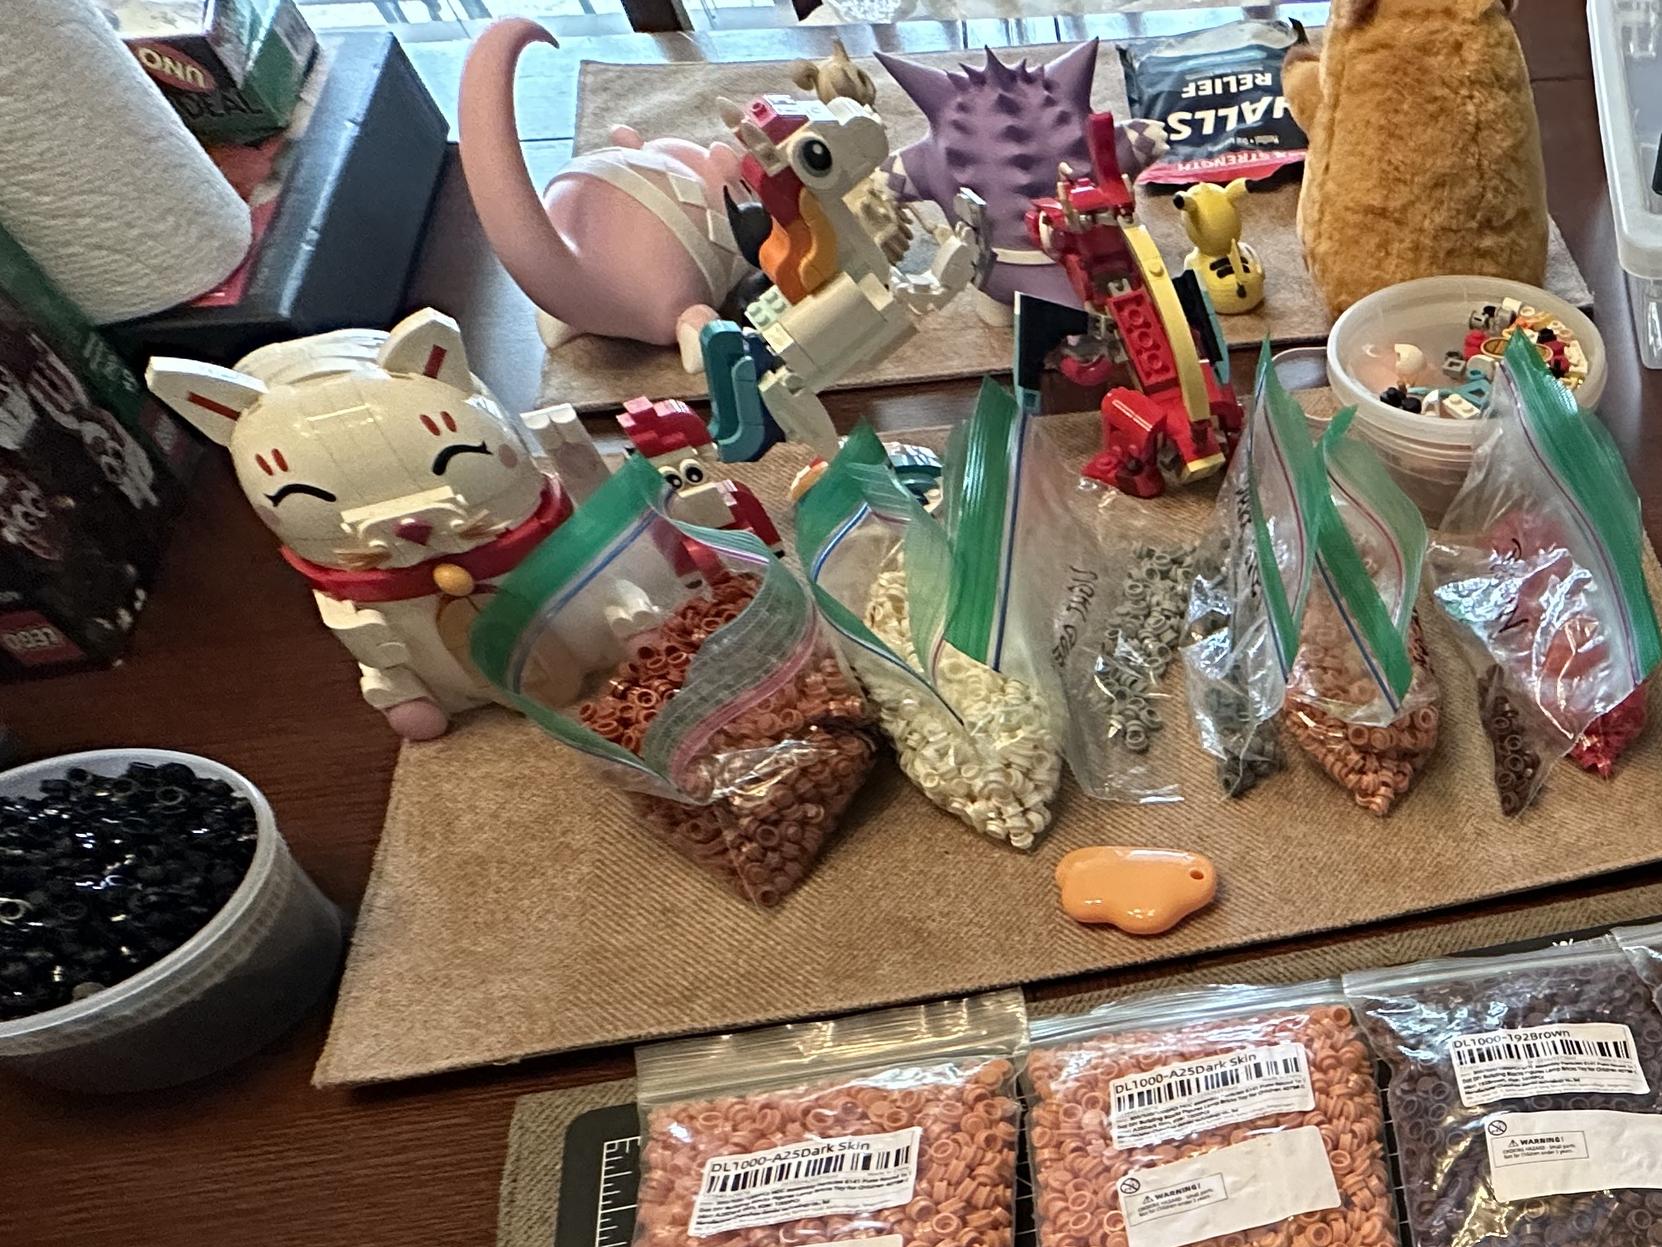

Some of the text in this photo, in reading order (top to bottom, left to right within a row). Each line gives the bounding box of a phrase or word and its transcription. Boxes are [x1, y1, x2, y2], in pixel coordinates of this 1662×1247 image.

[137, 47, 206, 88] UNO
[1181, 72, 1272, 98] RELIEF
[1167, 96, 1290, 141] HALLS
[1177, 151, 1270, 172] STRENGTH
[1454, 1030, 1571, 1049] DL1000-192Brown
[1115, 1052, 1257, 1095] DL1000-A25Dark Skin
[711, 1140, 870, 1173] DL1000-A25Dark Skin
